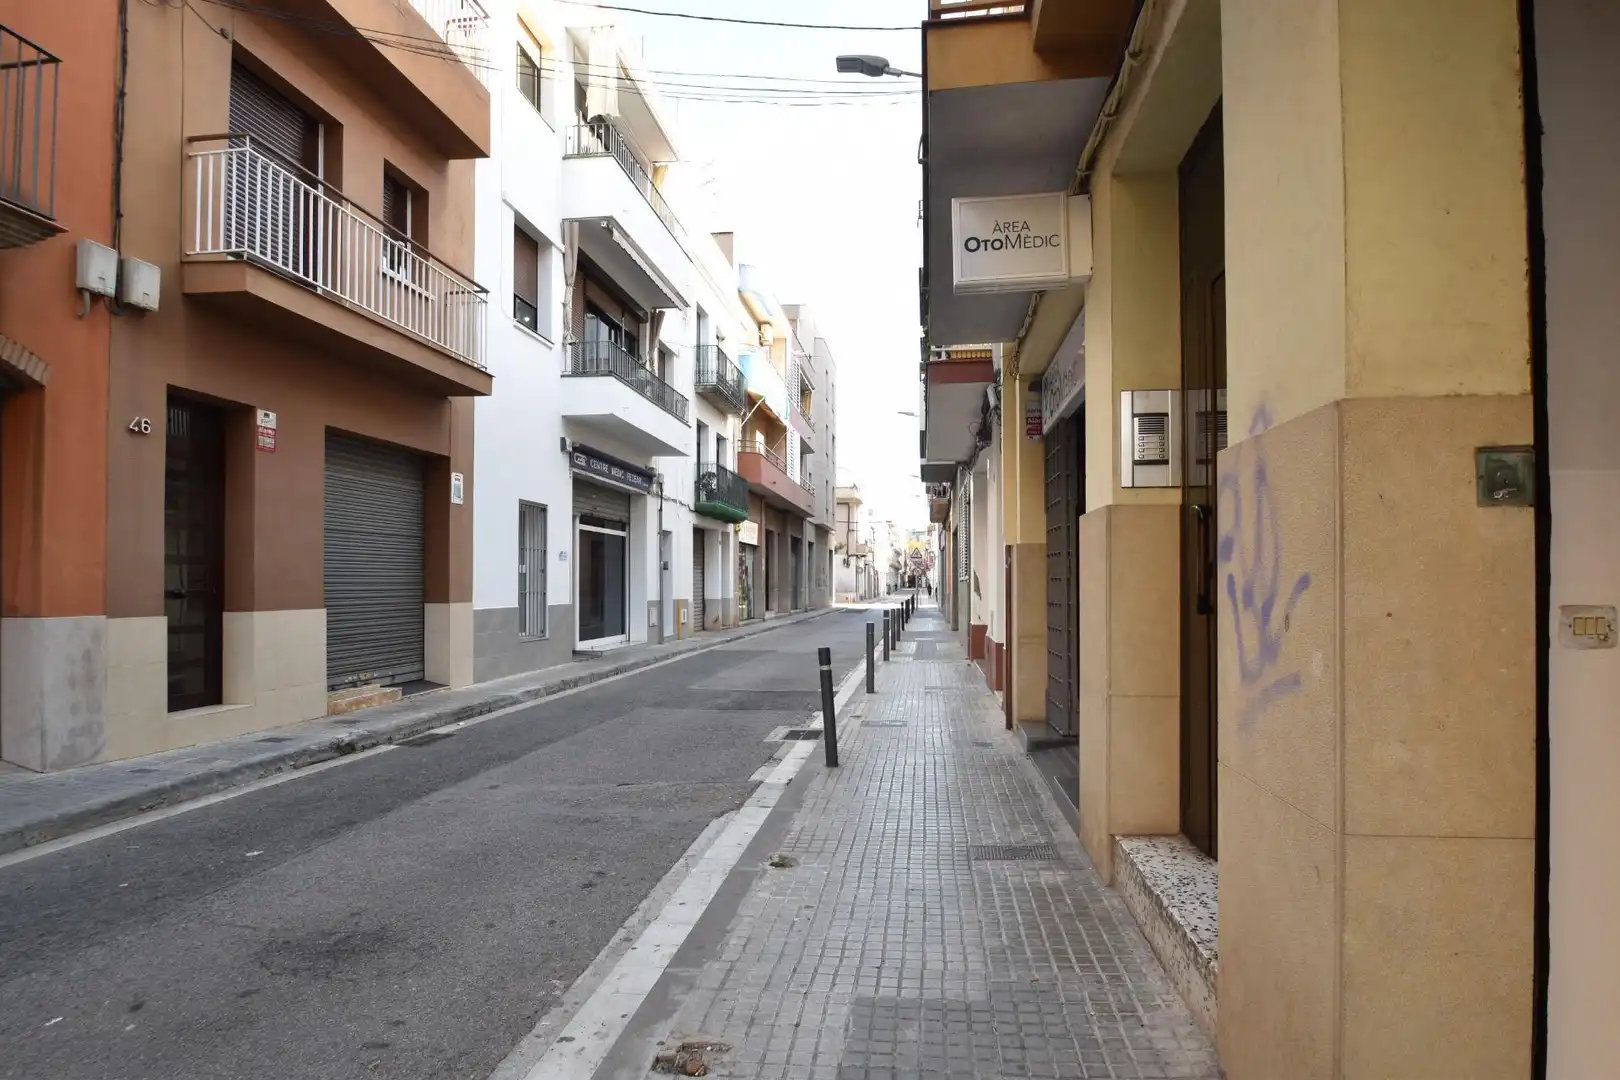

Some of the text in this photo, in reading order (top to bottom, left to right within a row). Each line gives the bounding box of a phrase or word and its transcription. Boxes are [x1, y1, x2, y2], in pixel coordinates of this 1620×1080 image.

[992, 219, 1031, 235] ÀREA
[129, 416, 151, 434] 46
[590, 459, 609, 474] CENTRE
